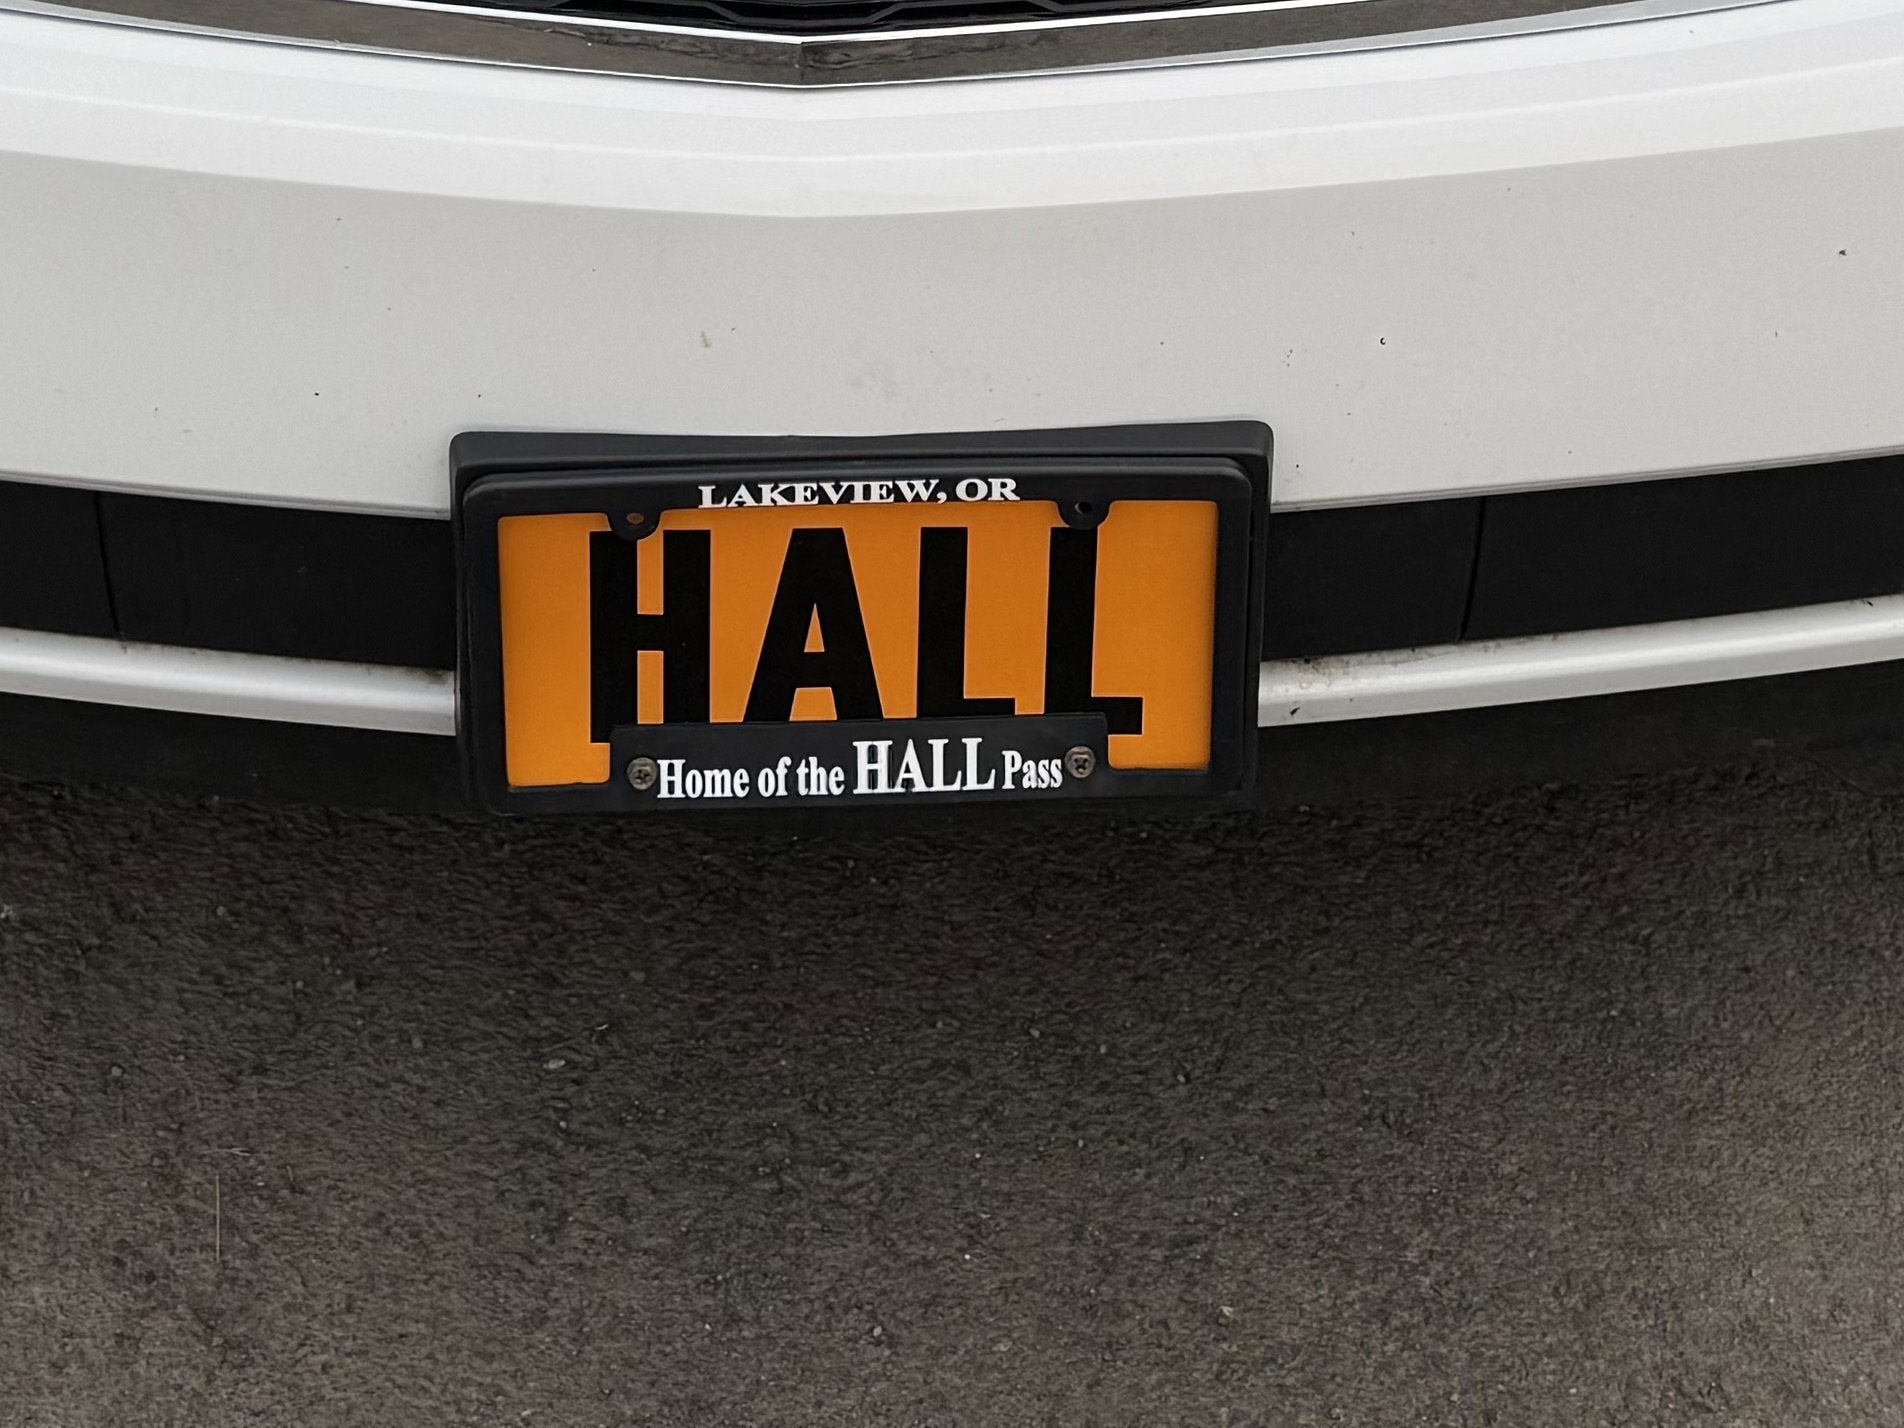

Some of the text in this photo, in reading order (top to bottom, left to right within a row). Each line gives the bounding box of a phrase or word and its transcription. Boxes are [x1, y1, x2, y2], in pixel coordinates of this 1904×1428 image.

[698, 477, 1021, 509] LAKEVIEW, OR
[589, 526, 1143, 743] HALL
[656, 737, 1063, 799] Home of the HALL Pass
